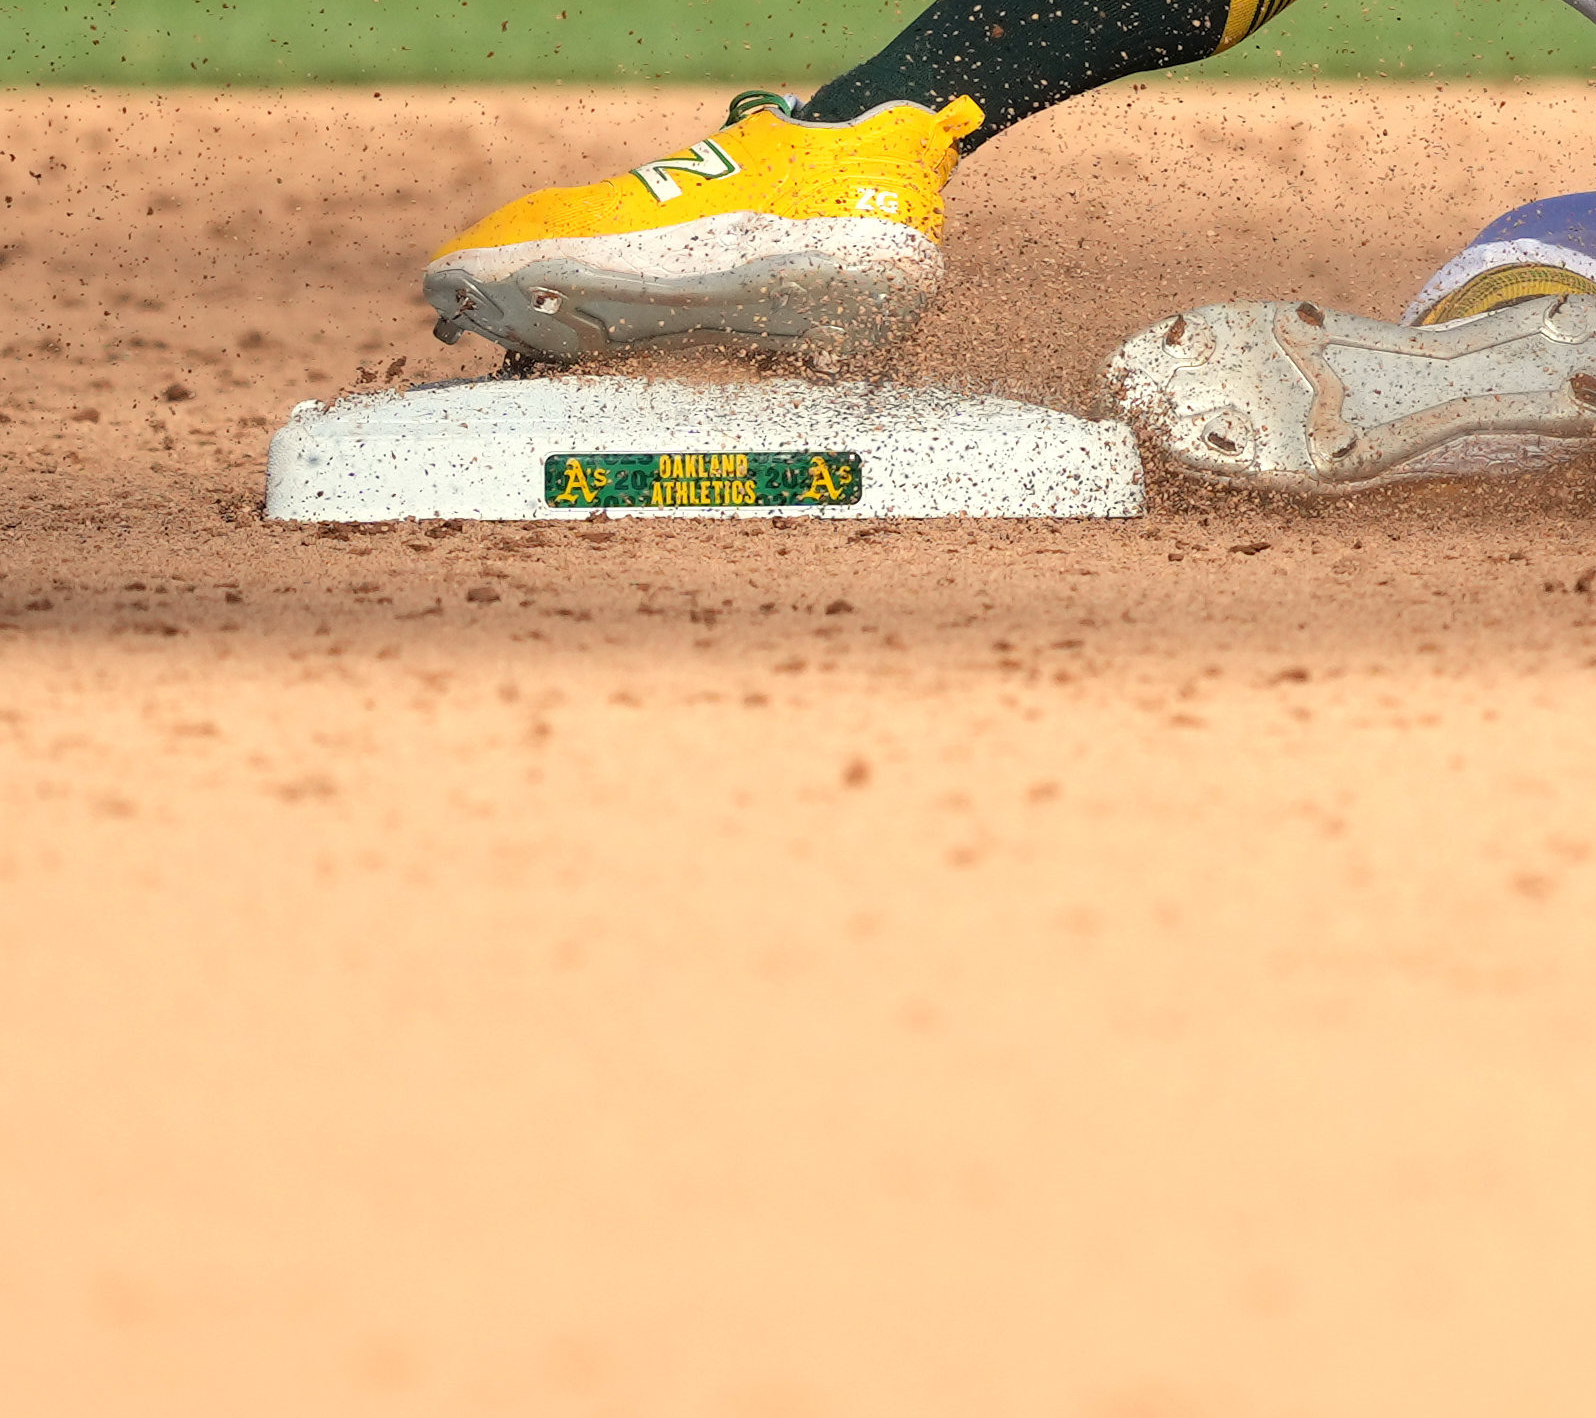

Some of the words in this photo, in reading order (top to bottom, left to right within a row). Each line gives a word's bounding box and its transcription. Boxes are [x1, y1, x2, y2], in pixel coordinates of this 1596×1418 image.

[854, 187, 900, 214] ZG
[553, 456, 609, 503] A's
[658, 453, 749, 479] OAKLAND
[650, 479, 757, 506] ATHLETICS
